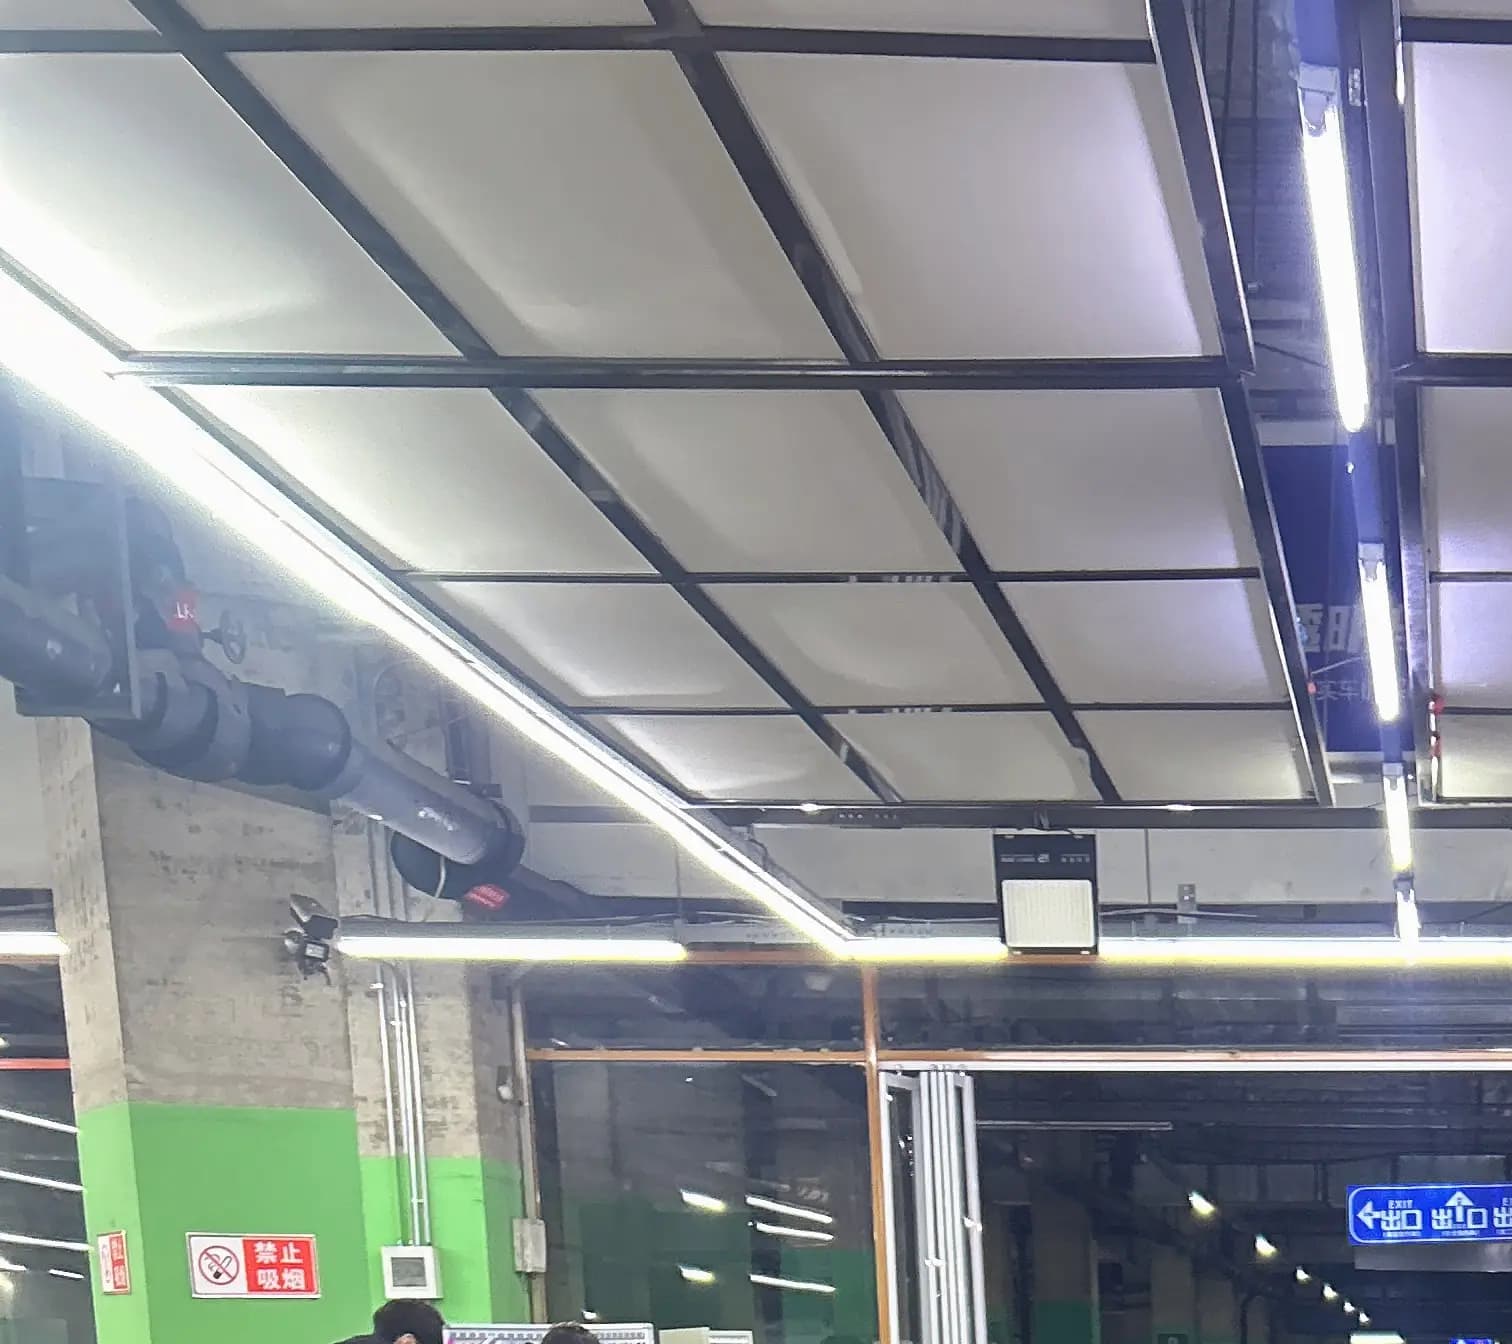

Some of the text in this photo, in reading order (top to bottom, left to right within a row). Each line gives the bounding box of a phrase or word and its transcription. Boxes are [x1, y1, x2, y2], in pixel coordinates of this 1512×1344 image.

[1388, 1200, 1413, 1209] EXIT
[1381, 1209, 1422, 1231] 出口
[254, 1241, 304, 1265] 禁止
[256, 1268, 305, 1291] 吸烟
